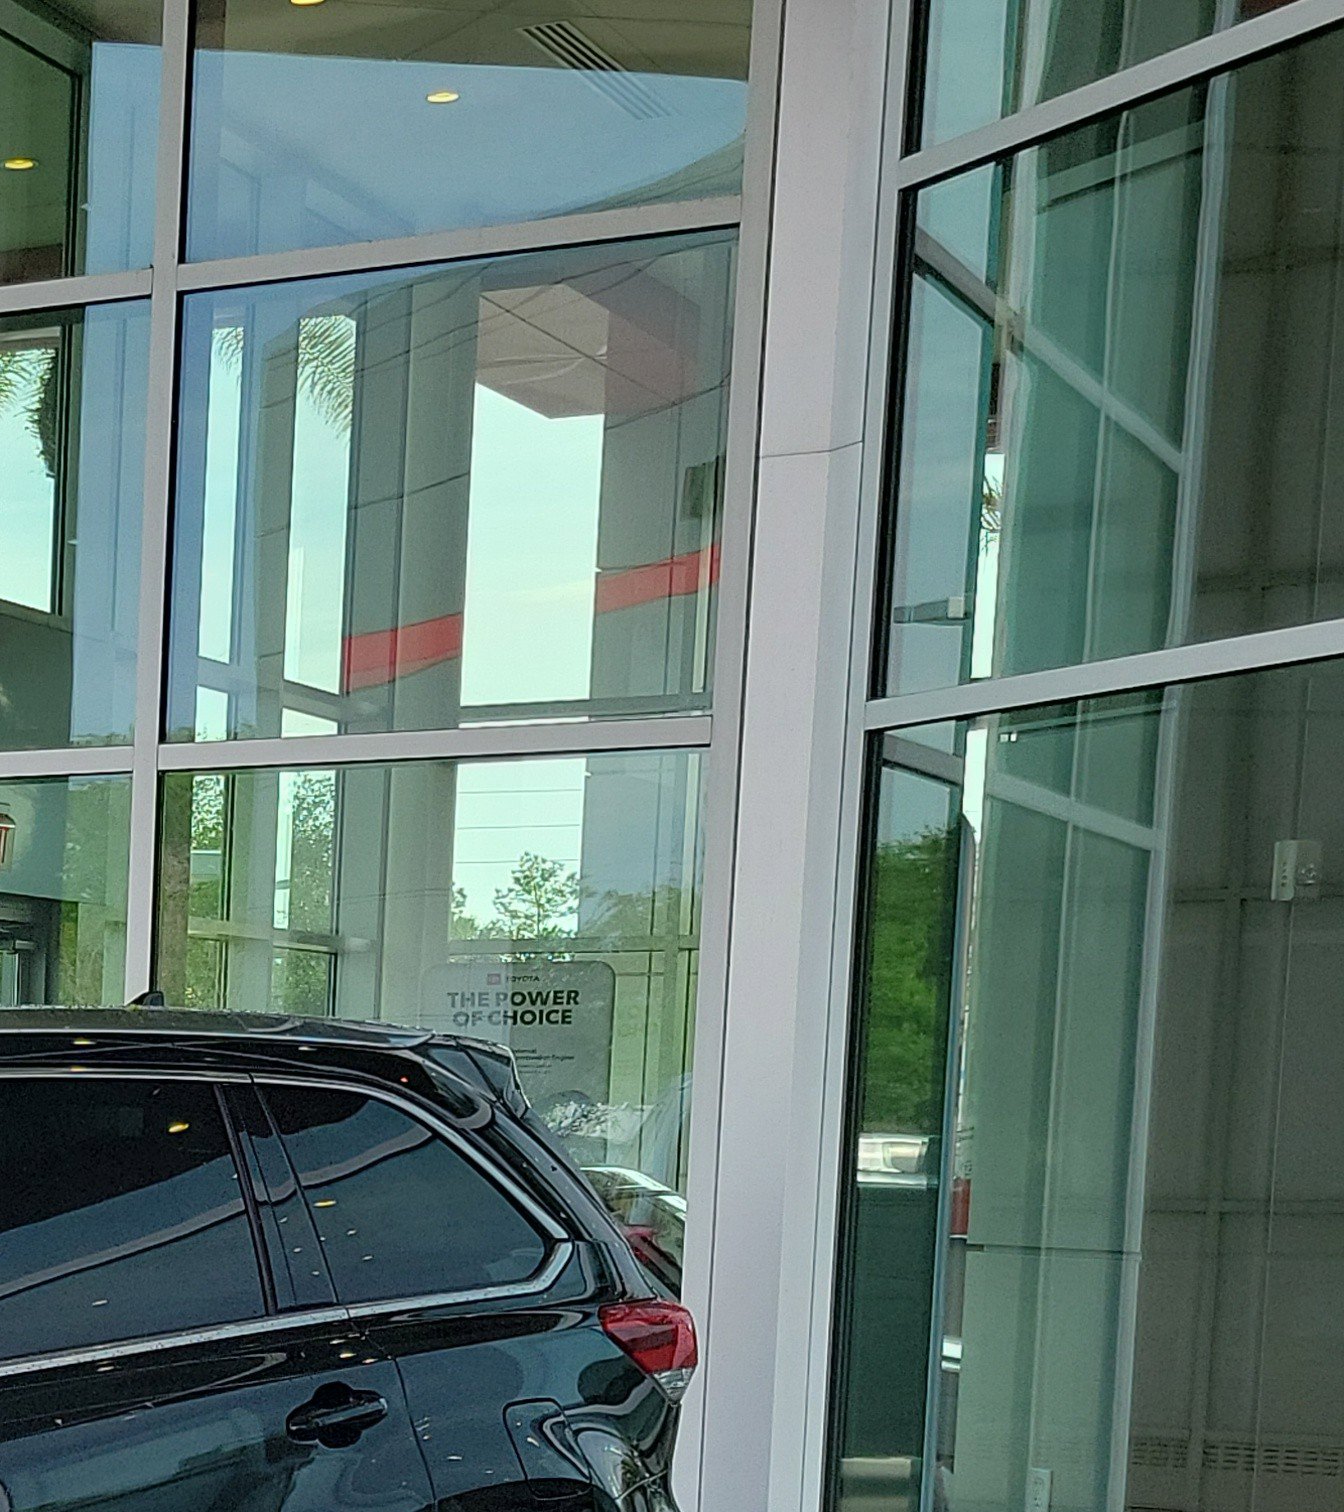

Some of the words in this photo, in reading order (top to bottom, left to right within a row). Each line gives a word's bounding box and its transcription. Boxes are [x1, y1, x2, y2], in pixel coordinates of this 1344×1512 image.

[447, 992, 490, 1008] THE
[495, 989, 580, 1007] POWER
[452, 1011, 483, 1027] OF
[488, 1009, 572, 1026] CHOICE
